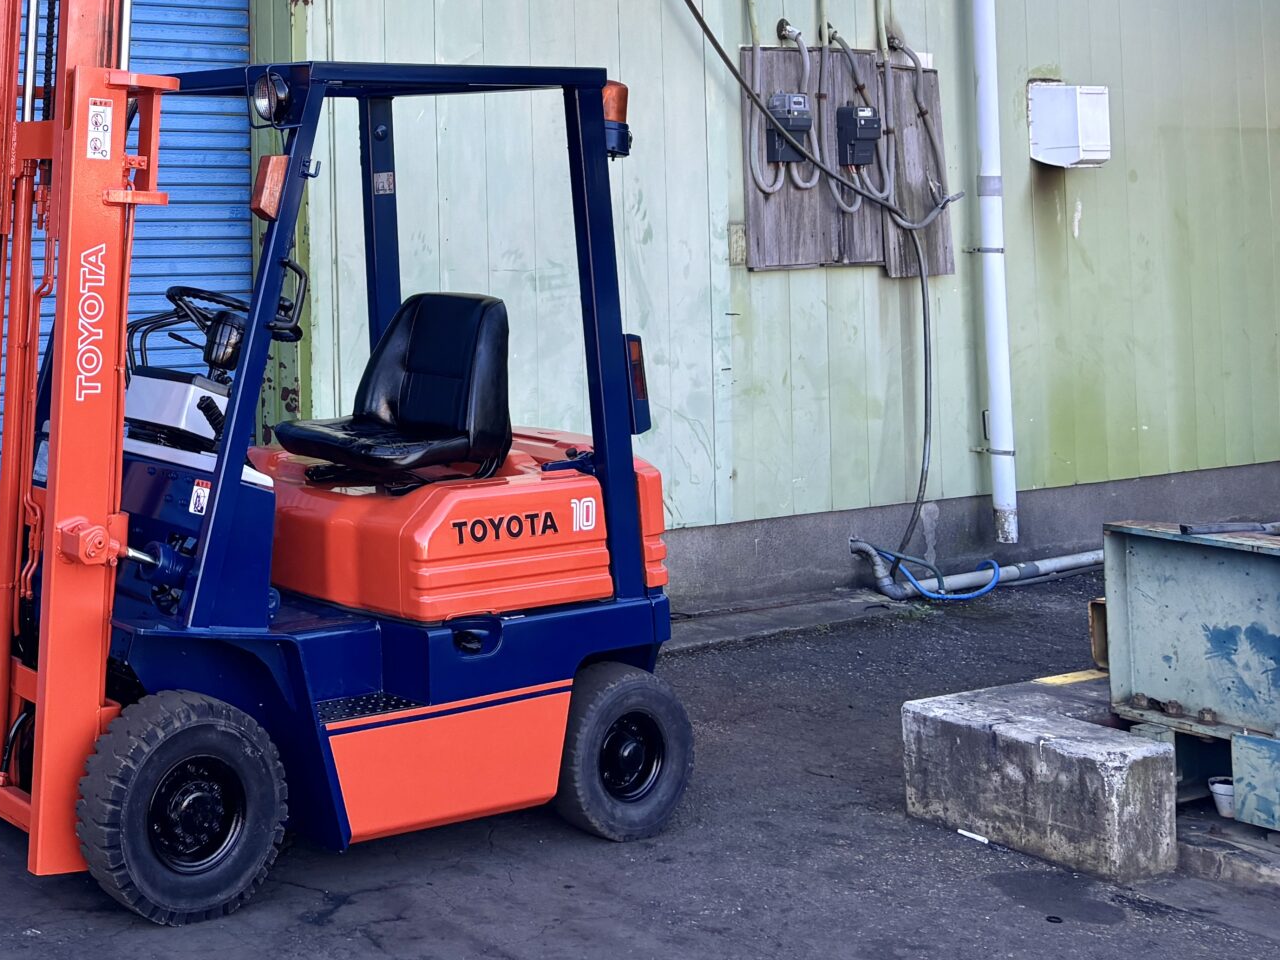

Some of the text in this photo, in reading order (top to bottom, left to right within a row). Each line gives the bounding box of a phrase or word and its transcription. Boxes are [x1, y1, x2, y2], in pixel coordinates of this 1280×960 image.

[76, 243, 106, 401] TOYOTA
[451, 497, 596, 545] TOYOTA 10
